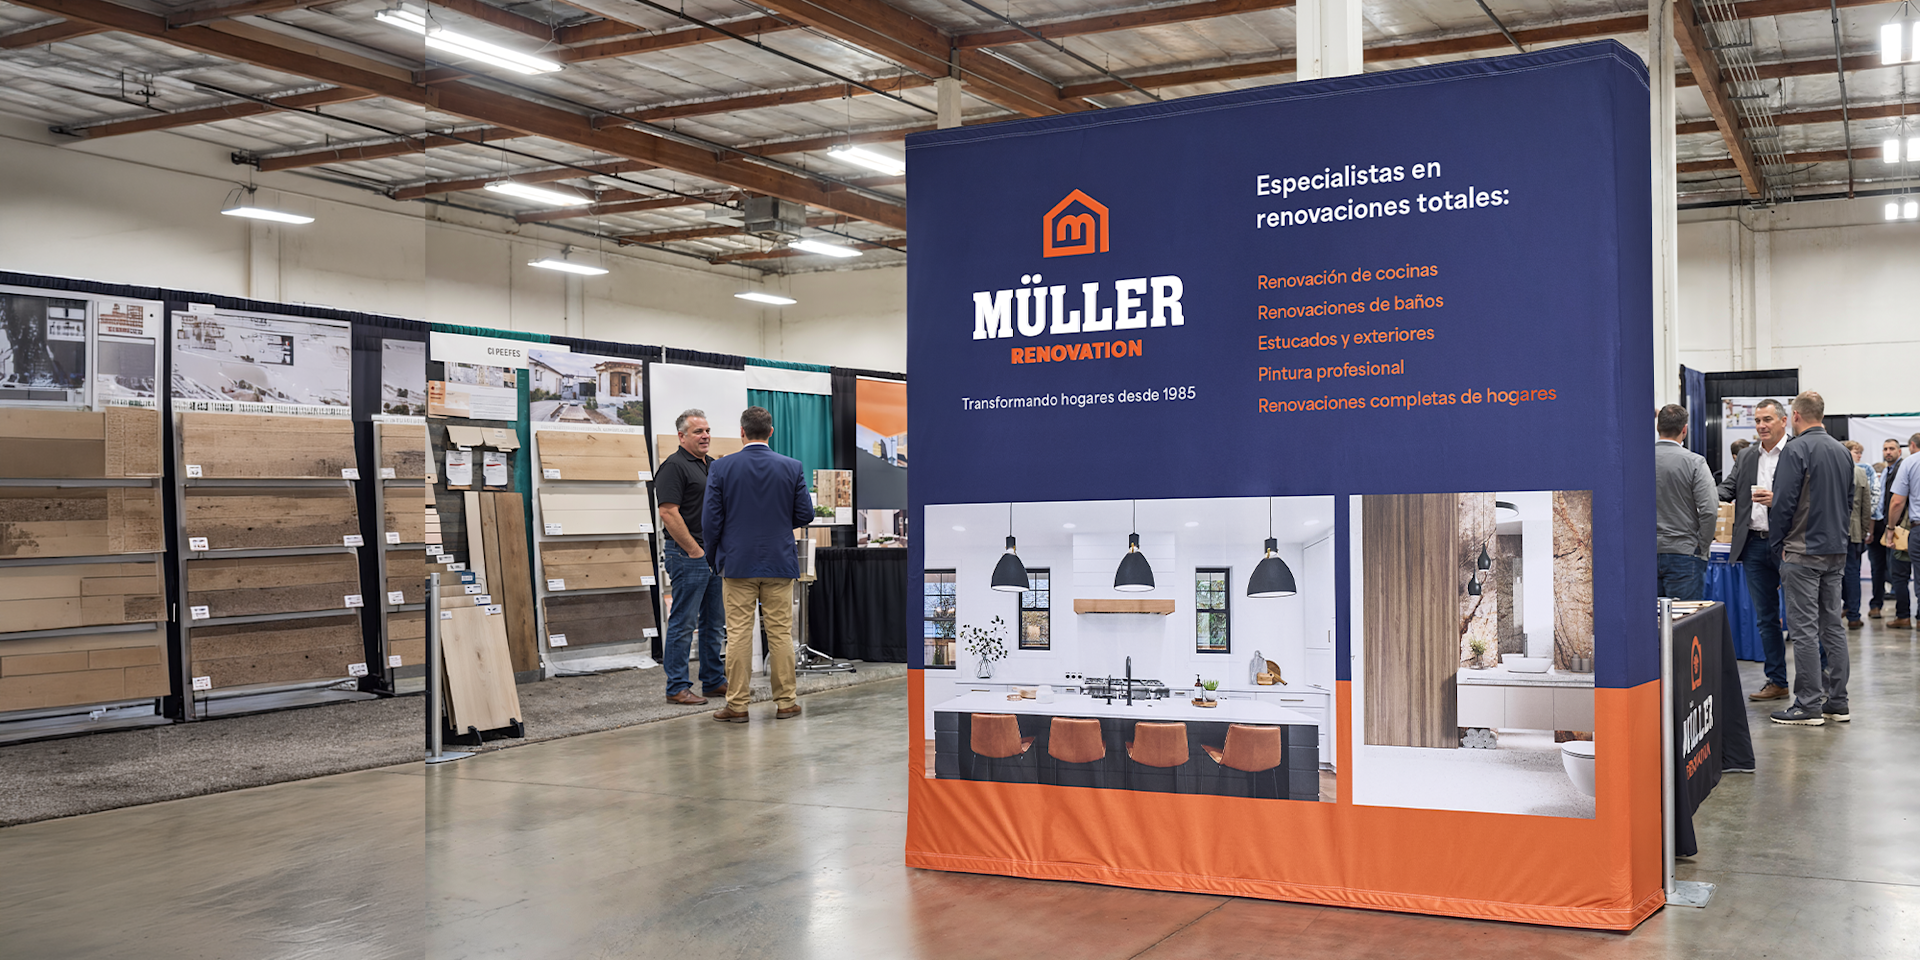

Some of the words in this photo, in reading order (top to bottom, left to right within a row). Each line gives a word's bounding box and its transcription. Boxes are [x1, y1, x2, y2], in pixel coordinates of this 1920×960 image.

[1256, 164, 1405, 199] Especialistas
[1411, 161, 1441, 180] en
[1256, 198, 1411, 229] renovaciones
[1416, 185, 1510, 213] totales:
[1257, 268, 1348, 290] Renovación
[1350, 266, 1372, 283] de
[1375, 262, 1439, 281] cocinas
[972, 273, 1185, 340] MÜLLER
[1257, 300, 1366, 321] Renovaciones
[1369, 296, 1391, 313] de
[1394, 293, 1444, 311] baños
[1010, 338, 1143, 365] RENOVATION
[1258, 331, 1338, 351] Estucados
[1340, 333, 1351, 350] y
[1353, 326, 1435, 345] exteriores
[1258, 366, 1313, 382] Pintura
[1316, 358, 1405, 383] profesional
[961, 393, 1058, 411] Transformando
[1060, 392, 1115, 408] hogares
[1117, 387, 1160, 403] desde
[1162, 385, 1197, 401] 1985
[1258, 394, 1367, 414] Renovaciones
[1369, 390, 1457, 411] completas
[1460, 388, 1483, 405] de
[1486, 387, 1558, 407] hogares
